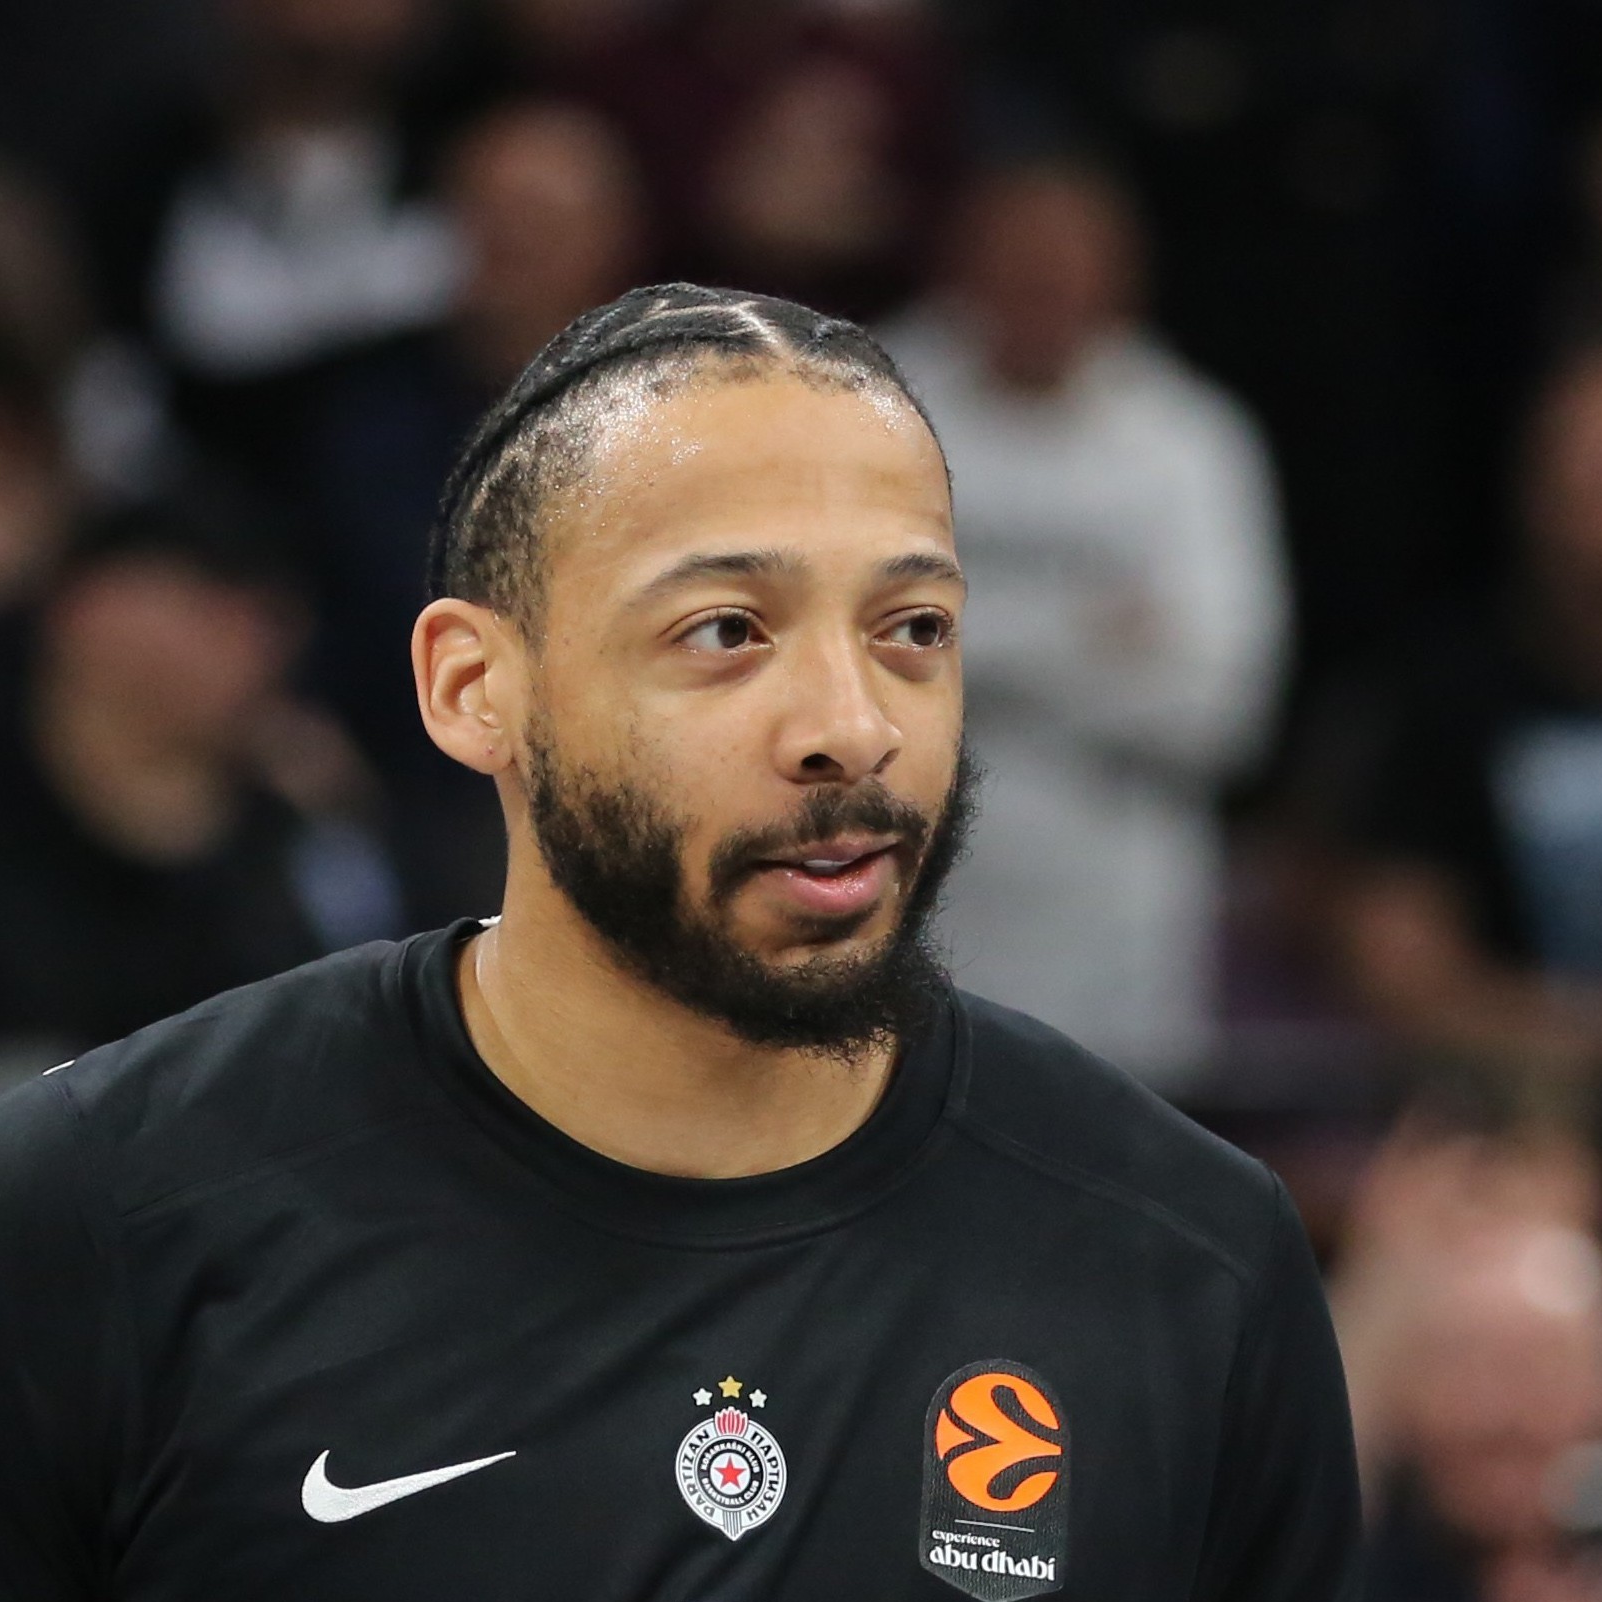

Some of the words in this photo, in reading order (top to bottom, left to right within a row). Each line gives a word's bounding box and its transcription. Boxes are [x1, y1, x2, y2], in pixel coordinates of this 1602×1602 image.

[682, 1429, 715, 1518] PARTIZAN
[746, 1431, 780, 1521] ПАРТИЗАН
[929, 1544, 978, 1573] abu
[981, 1549, 1056, 1582] dhabi
[932, 1528, 1000, 1549] experience
